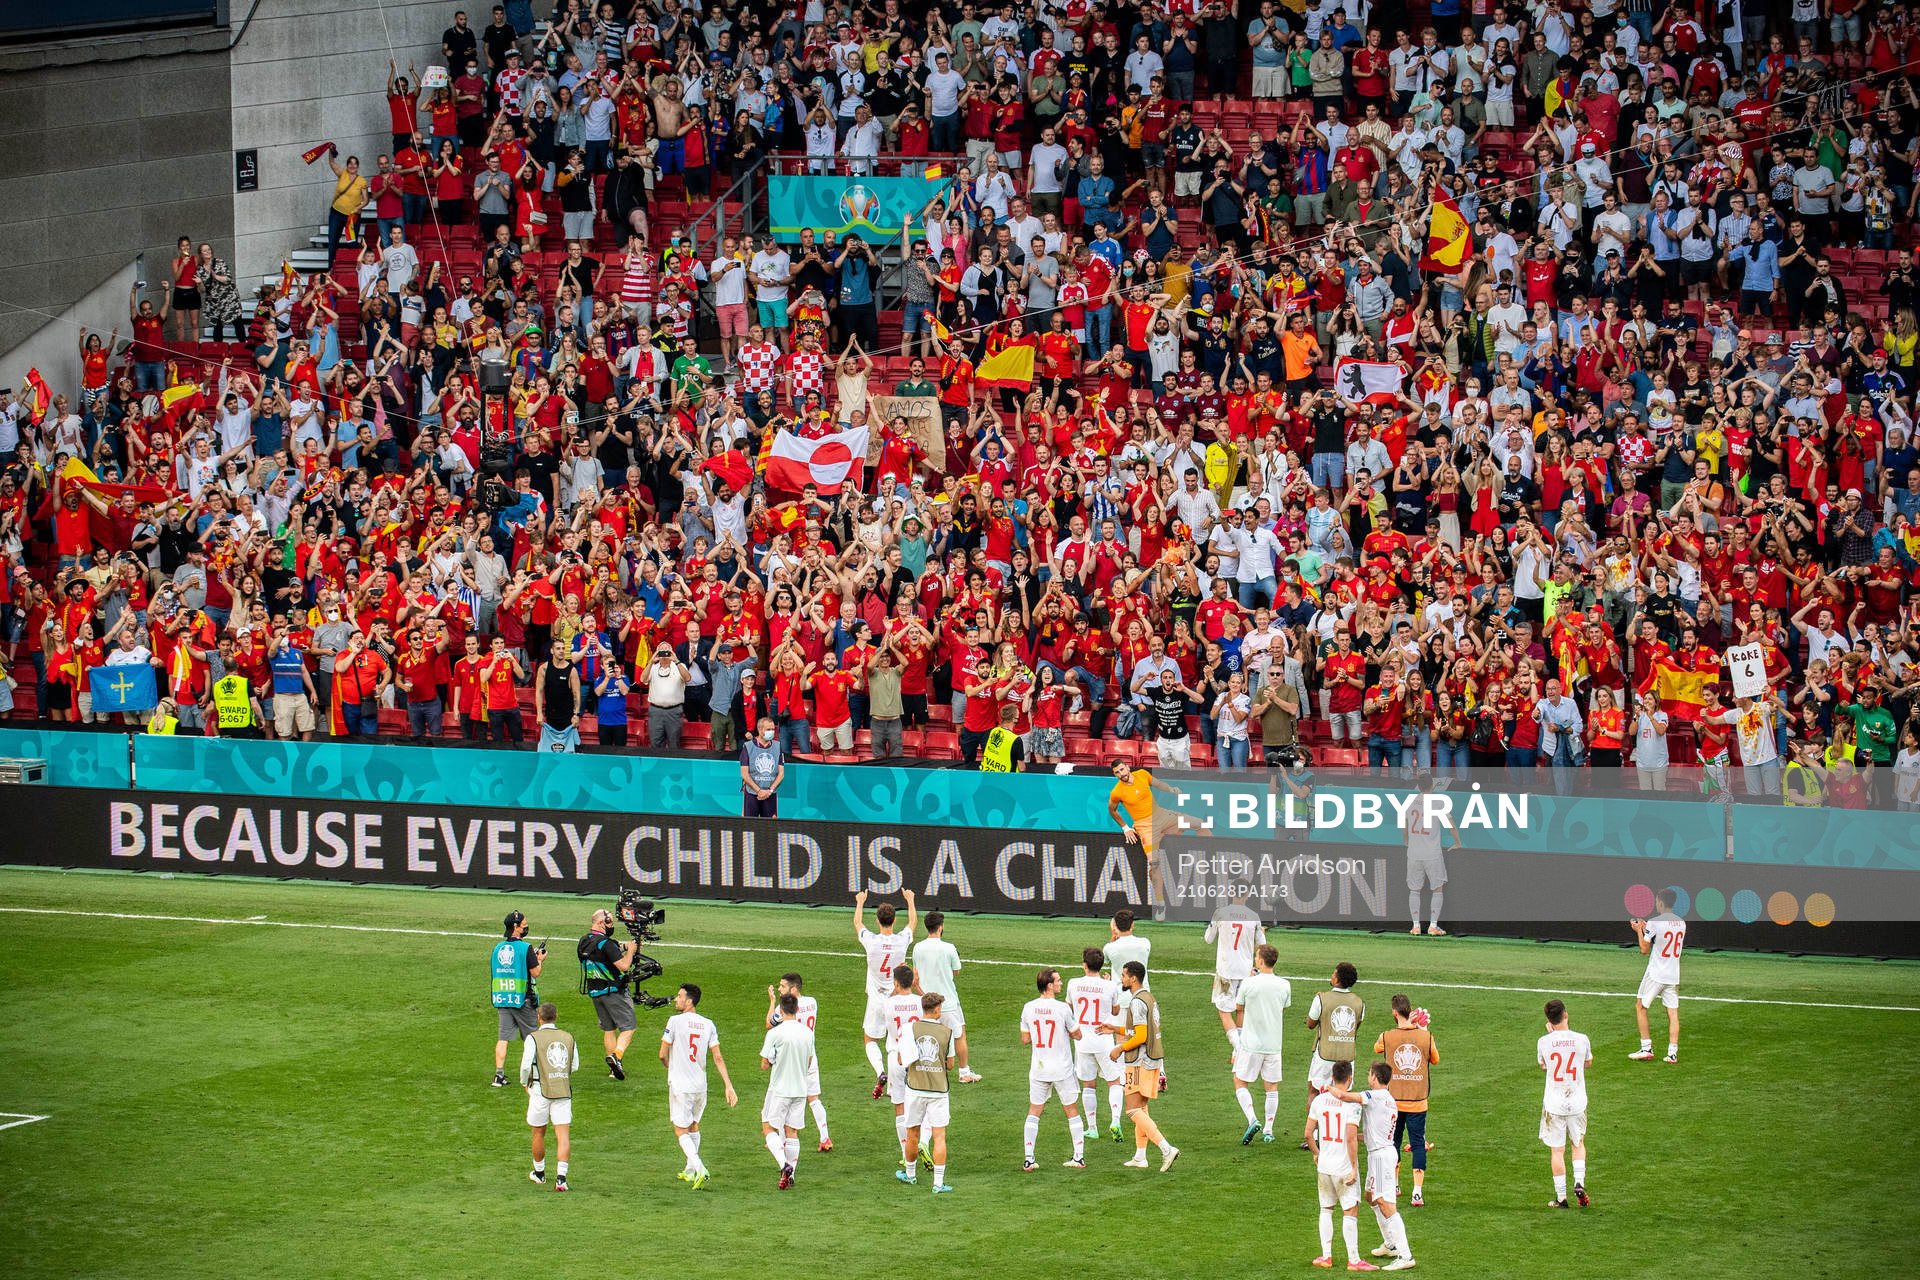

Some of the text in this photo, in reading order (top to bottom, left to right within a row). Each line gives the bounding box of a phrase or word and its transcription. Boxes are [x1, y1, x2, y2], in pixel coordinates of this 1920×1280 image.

[1731, 649, 1760, 663] KOKE
[495, 671, 508, 682] 22
[1744, 664, 1755, 677] 6
[219, 706, 248, 714] EWARD
[110, 801, 384, 870] BECAUSE
[407, 816, 602, 880] EVERY
[623, 825, 823, 890] CHILD
[848, 835, 903, 895] IS
[924, 839, 974, 898] A
[1231, 923, 1243, 951] 7
[1661, 930, 1684, 959] 26
[879, 952, 891, 979] 4
[499, 979, 516, 991] HB
[1077, 996, 1103, 1026] 21
[689, 1033, 701, 1063] 5
[1033, 1019, 1056, 1049] 17
[1550, 1051, 1577, 1082] 24
[1322, 1110, 1343, 1143] 11
